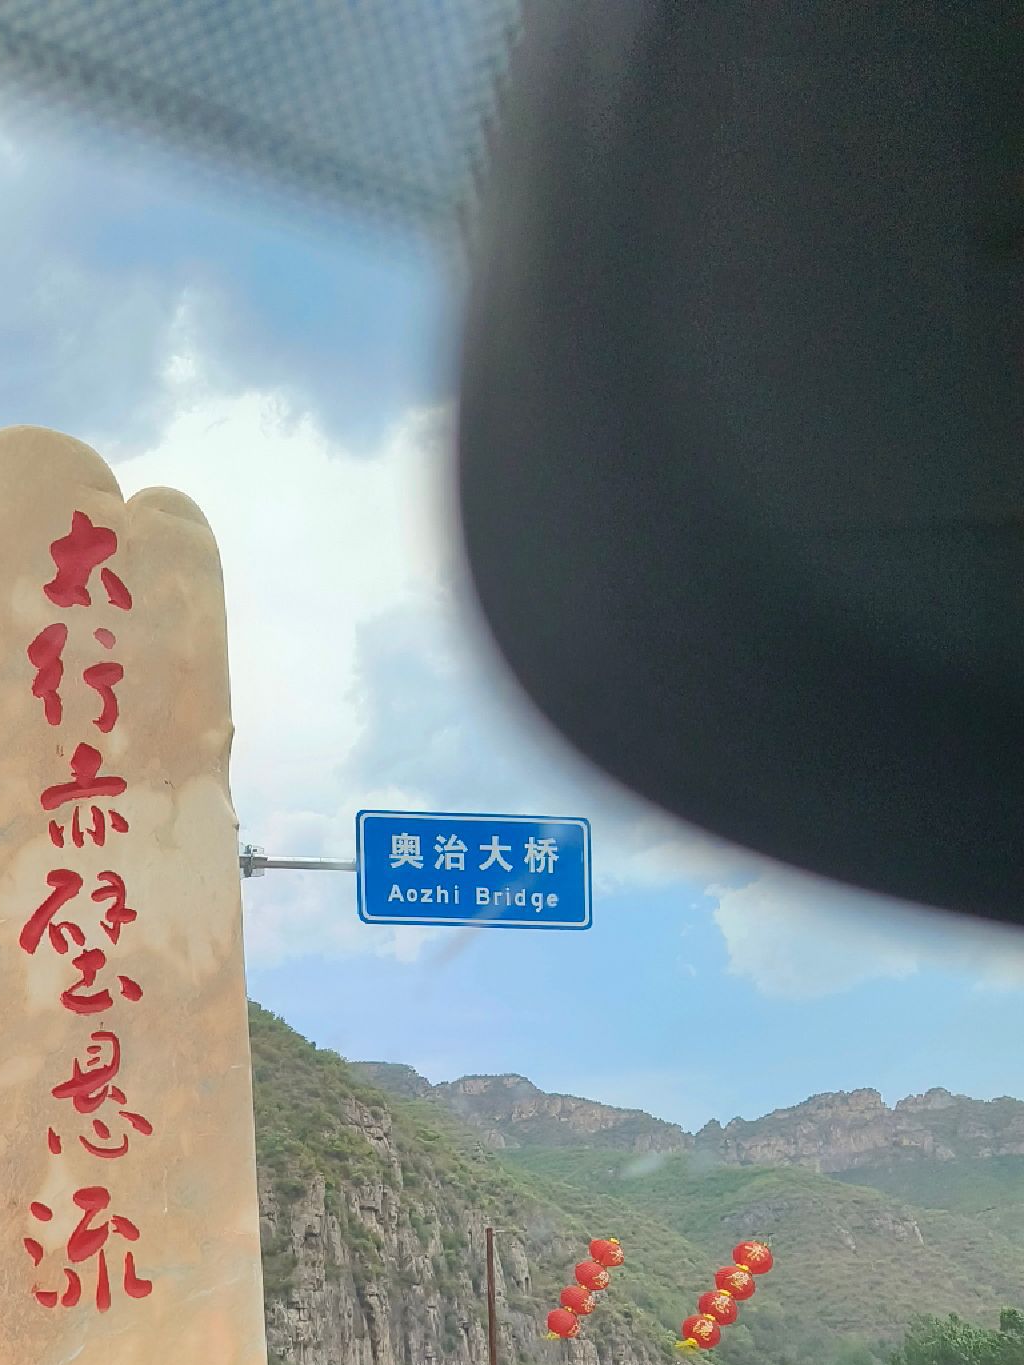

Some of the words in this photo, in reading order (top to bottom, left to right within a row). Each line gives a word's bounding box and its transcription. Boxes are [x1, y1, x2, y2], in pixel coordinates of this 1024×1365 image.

[388, 832, 559, 874] 奥治大桥
[388, 884, 460, 904] Aozhi
[475, 887, 559, 912] Bridge
